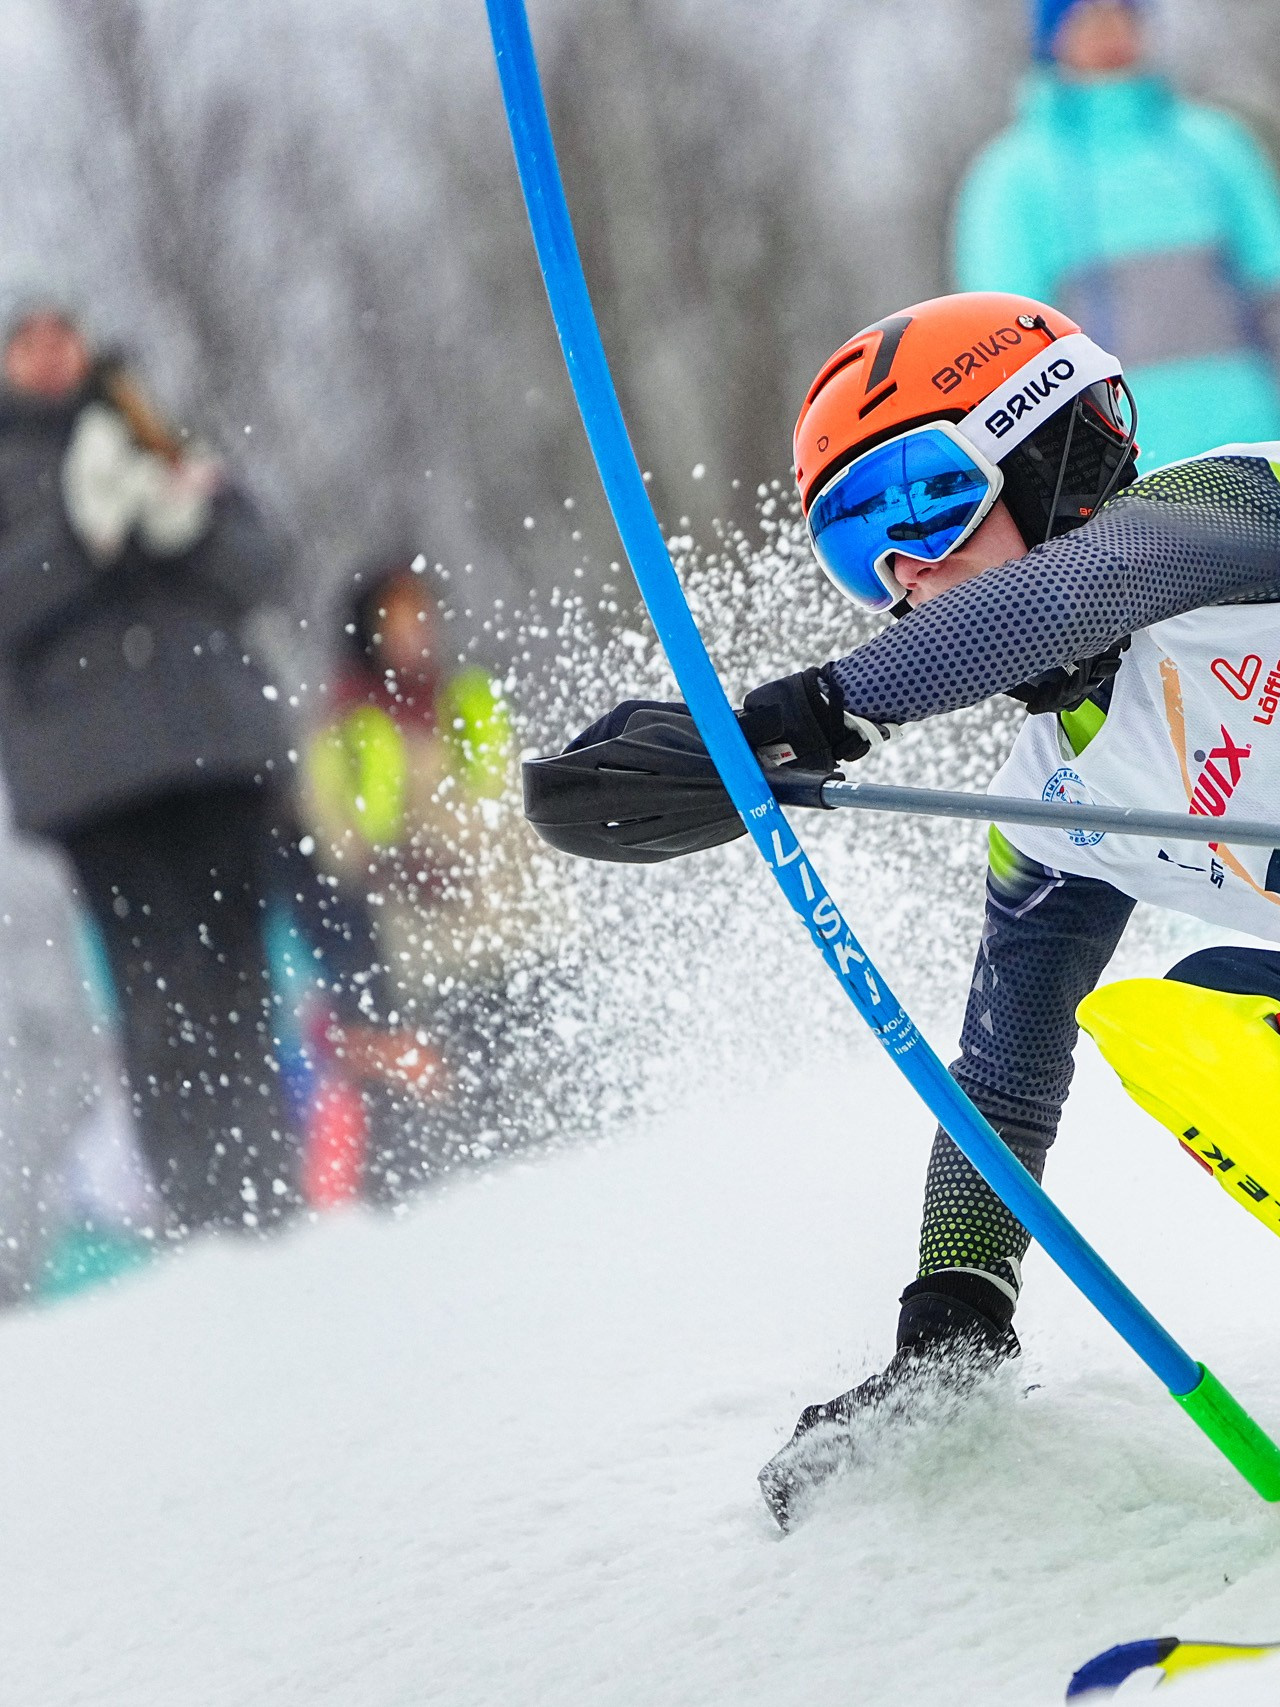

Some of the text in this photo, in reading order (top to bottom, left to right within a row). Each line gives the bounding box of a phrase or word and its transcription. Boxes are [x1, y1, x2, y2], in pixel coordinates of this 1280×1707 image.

[931, 327, 1022, 394] BRIKO
[984, 358, 1075, 439] BRIKO
[749, 803, 767, 820] TOP
[771, 829, 881, 1006] LISKI
